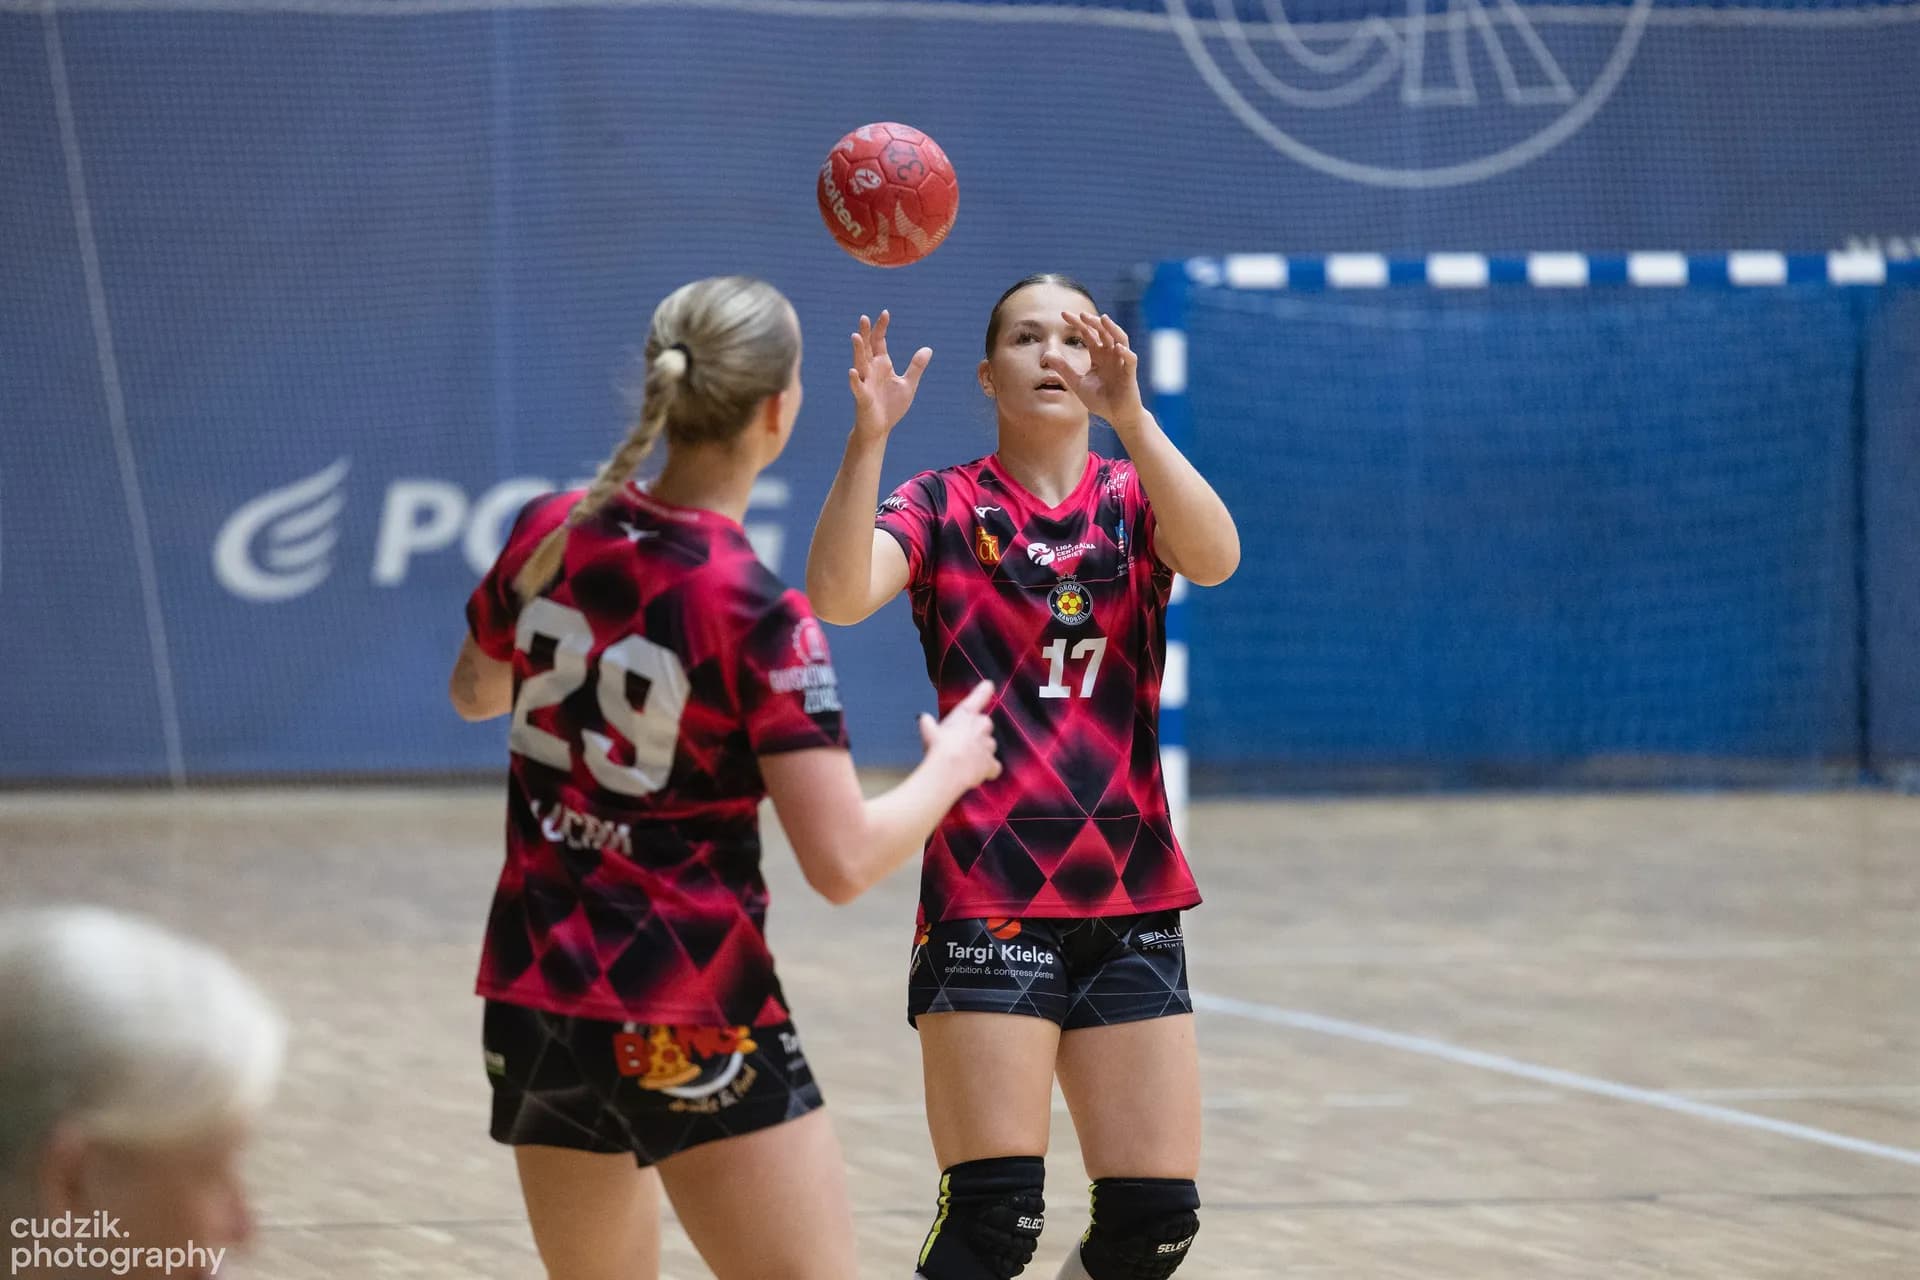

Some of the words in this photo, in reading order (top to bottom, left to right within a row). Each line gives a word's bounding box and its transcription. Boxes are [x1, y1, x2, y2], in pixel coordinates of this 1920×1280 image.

[1057, 550, 1083, 562] KOBIET
[1055, 584, 1081, 594] KORONA
[1057, 611, 1088, 623] HANDBALL
[1038, 637, 1108, 698] 17
[510, 596, 691, 797] 29
[946, 942, 993, 964] Targi
[1001, 944, 1054, 964] Kielce
[945, 966, 983, 974] exhibition
[984, 966, 992, 975] &
[993, 968, 1033, 977] congress
